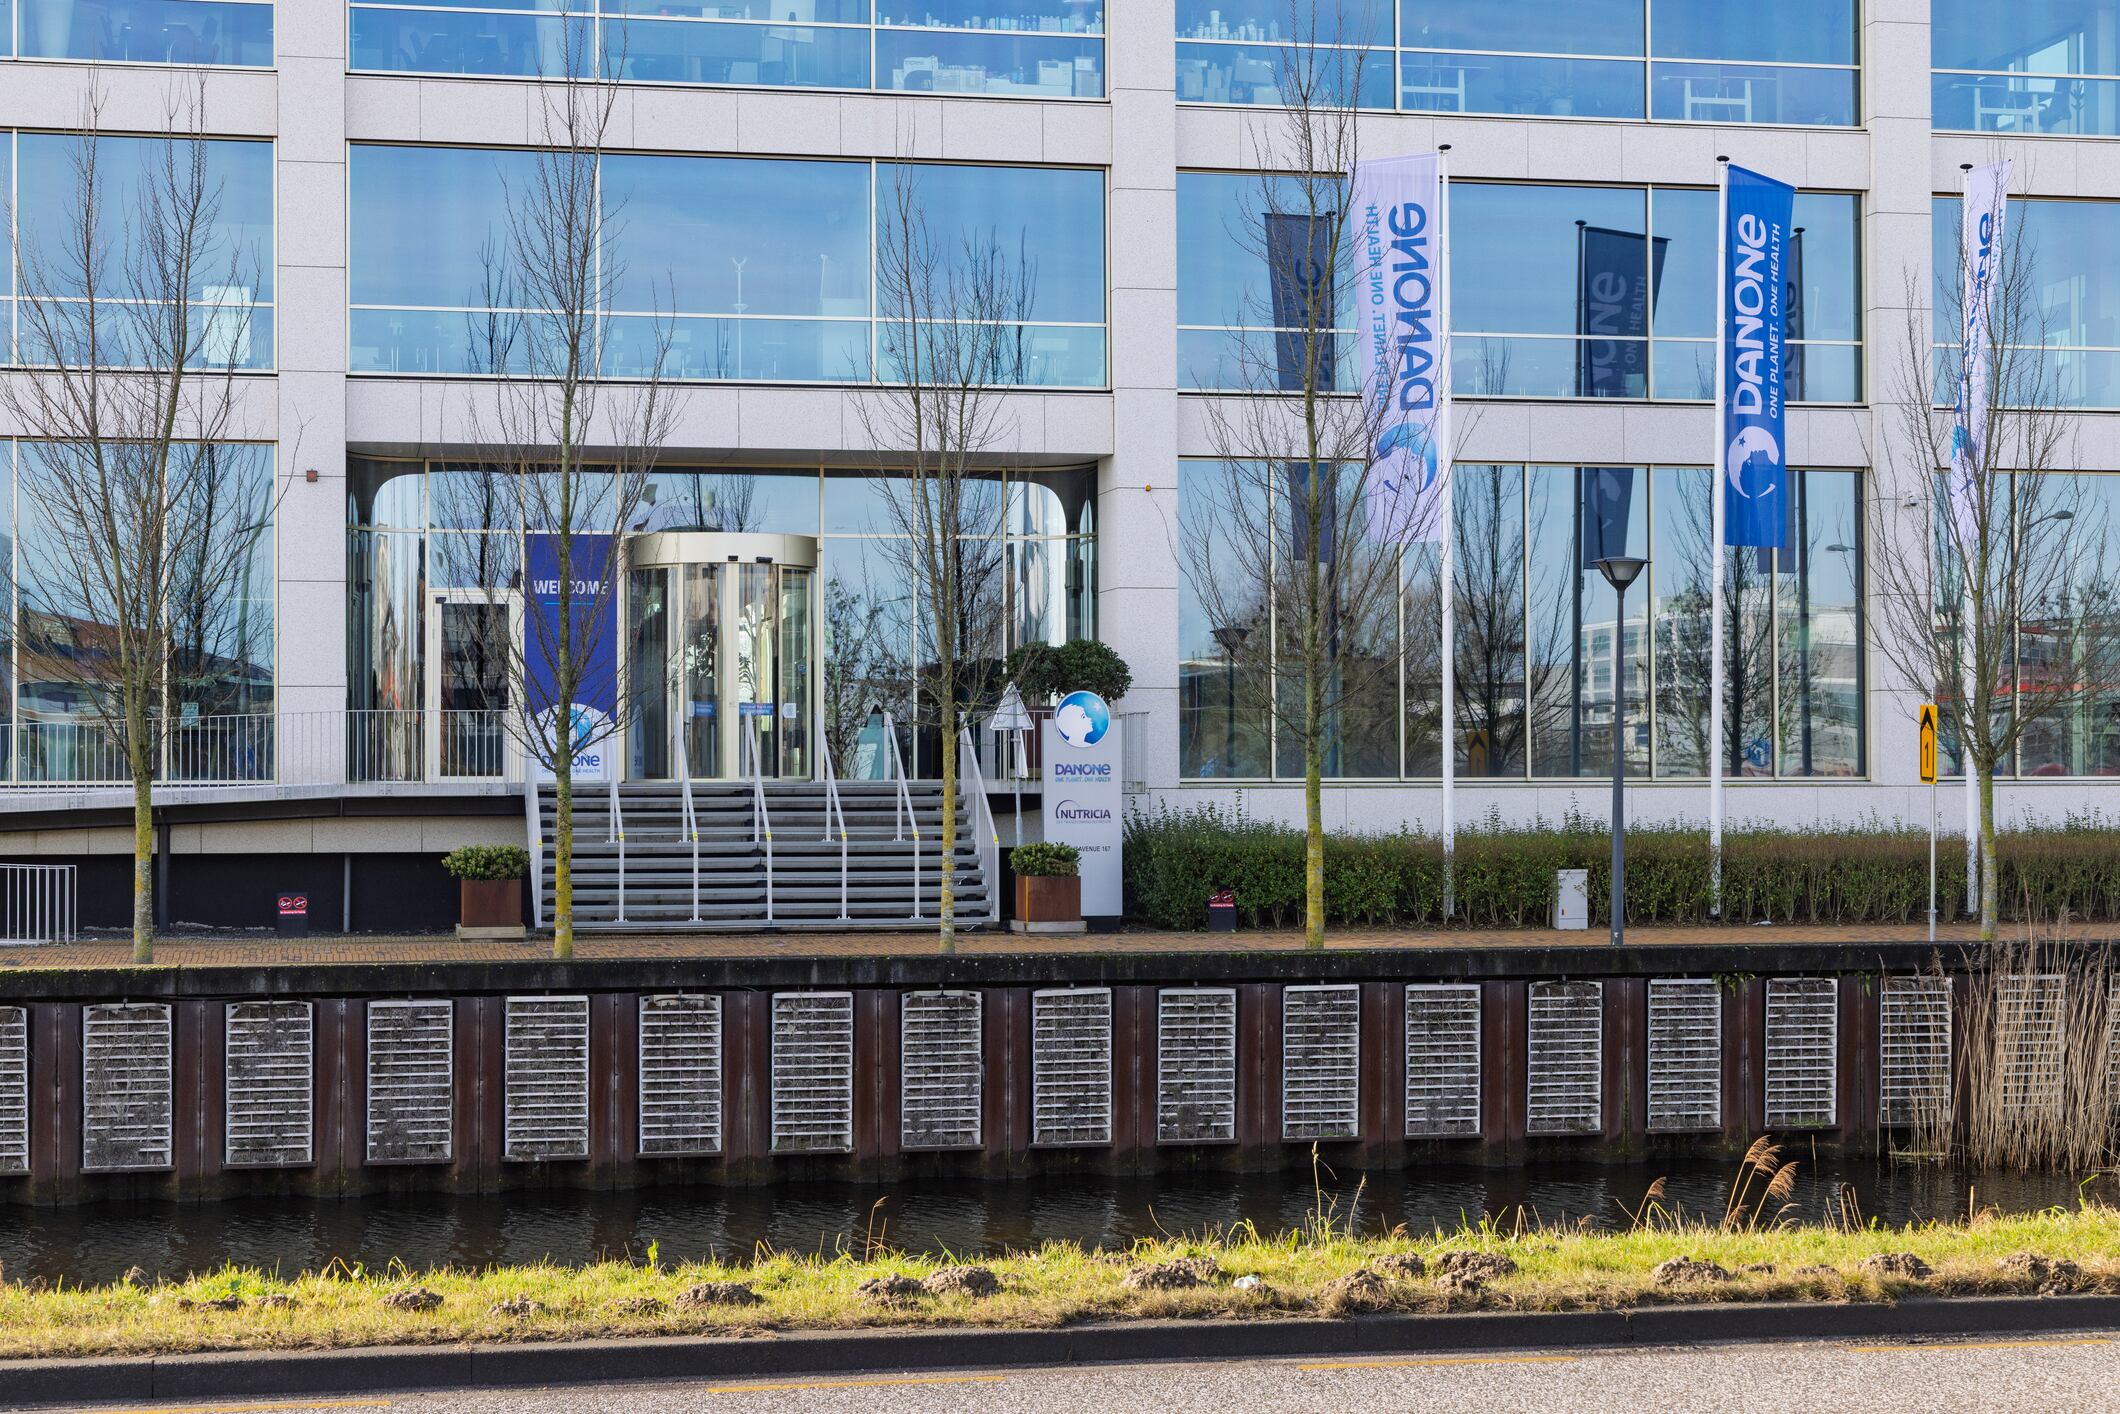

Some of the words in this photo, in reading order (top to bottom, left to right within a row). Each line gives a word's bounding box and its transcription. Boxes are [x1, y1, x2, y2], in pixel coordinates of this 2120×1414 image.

[1770, 223, 1781, 282] HEALTH
[1769, 283, 1778, 317] ONE
[1625, 335, 1638, 364] ON
[1769, 321, 1780, 384] PLANET.
[1769, 386, 1779, 419] ONE
[1060, 809, 1111, 819] NUTRICIA
